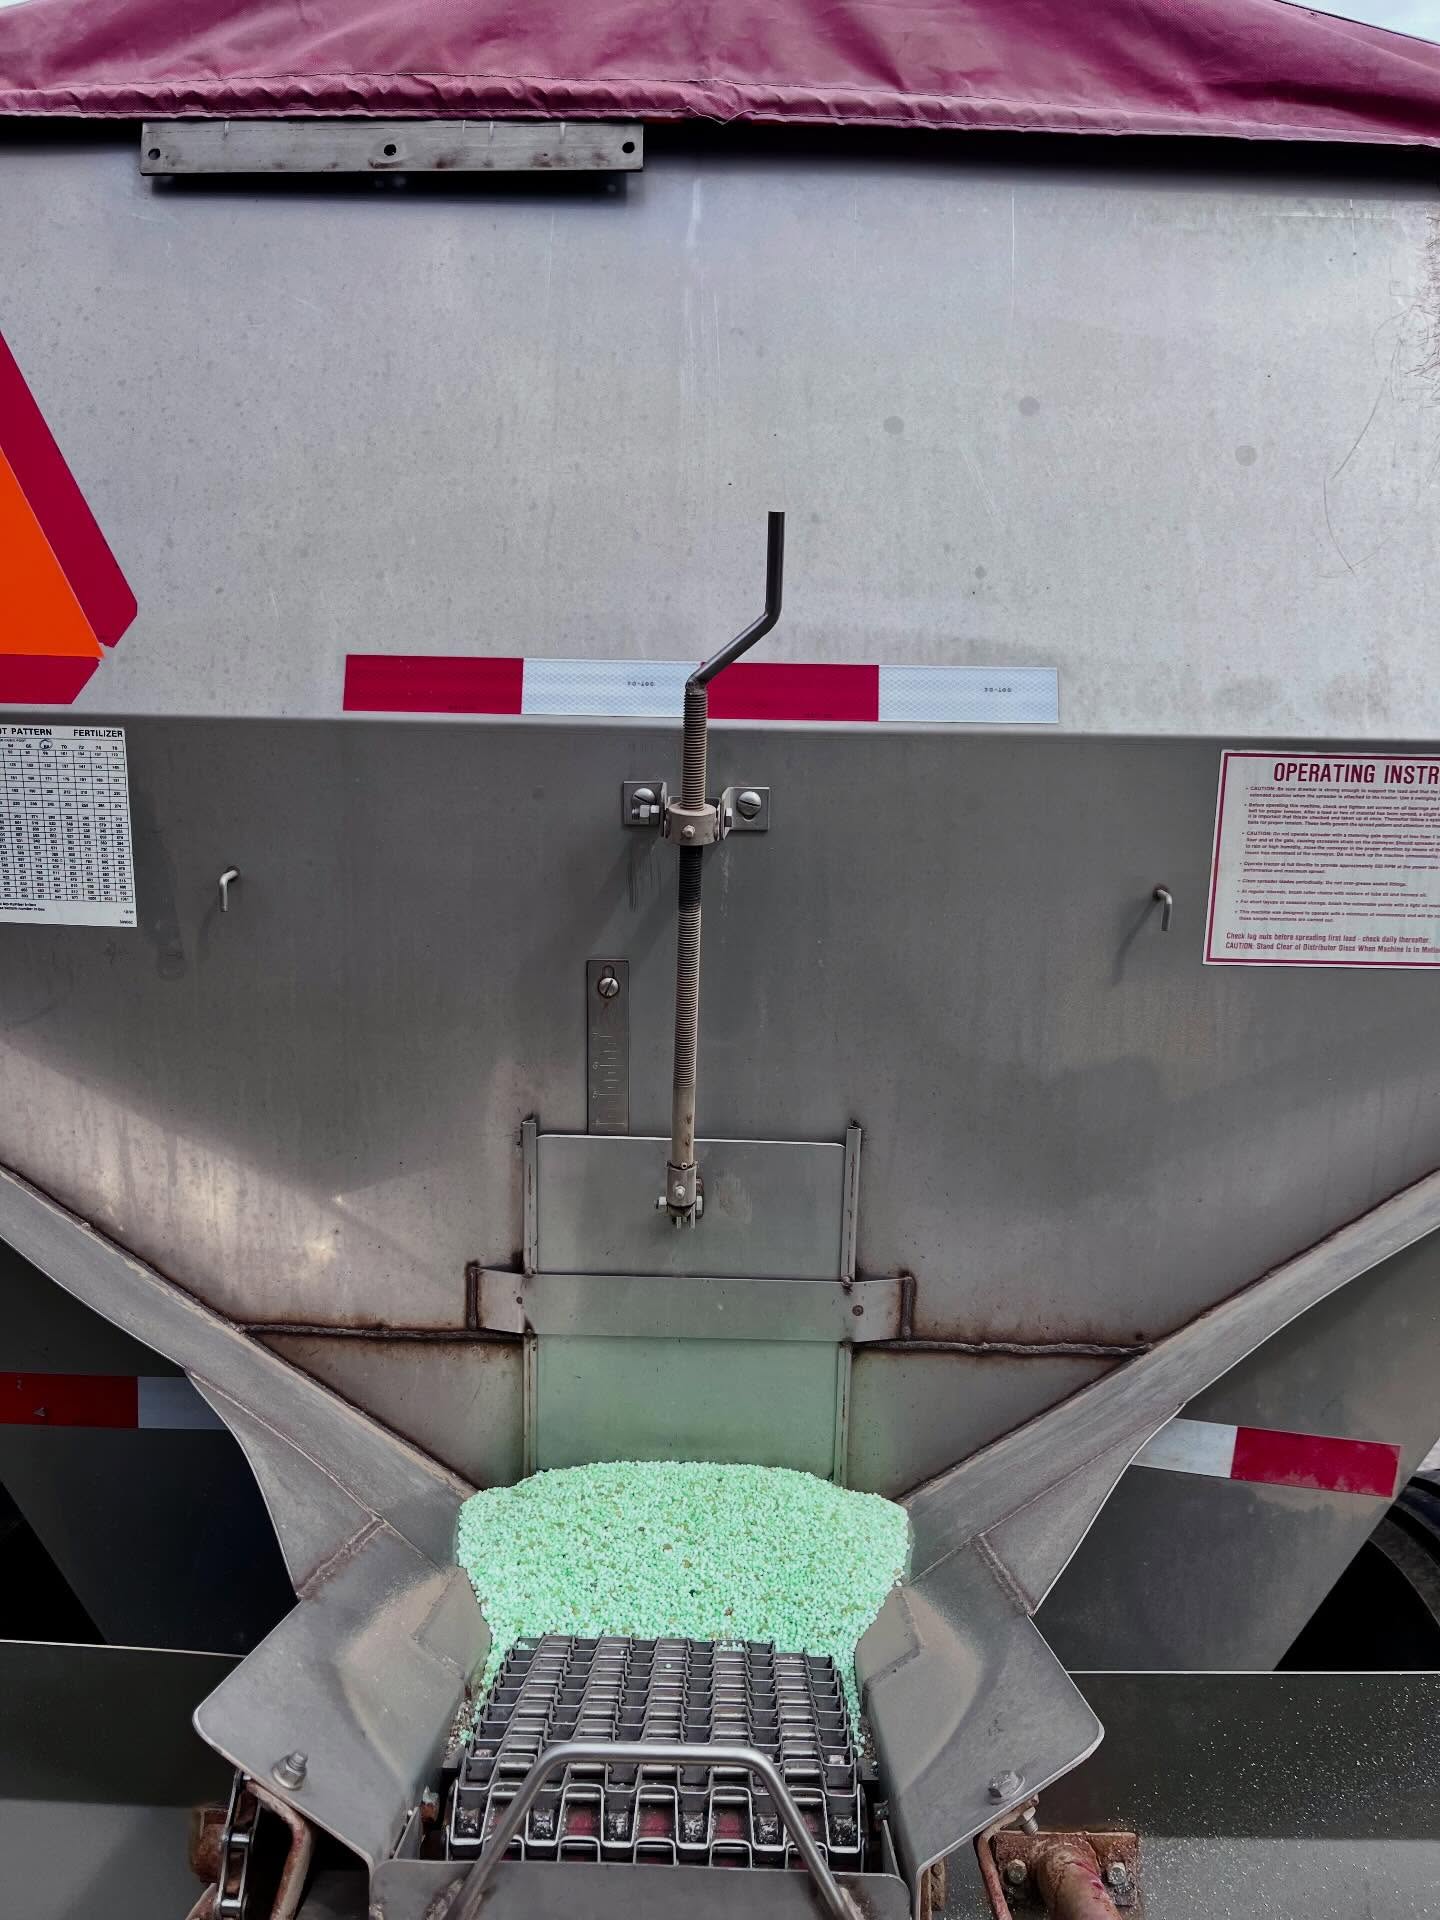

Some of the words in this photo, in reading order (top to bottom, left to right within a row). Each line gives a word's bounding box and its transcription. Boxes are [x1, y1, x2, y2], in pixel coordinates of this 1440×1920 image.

[1274, 763, 1376, 783] OPERATING
[1384, 765, 1439, 784] INSTR
[1247, 933, 1257, 941] lug
[1296, 934, 1326, 942] spreading
[1382, 936, 1397, 944] daily
